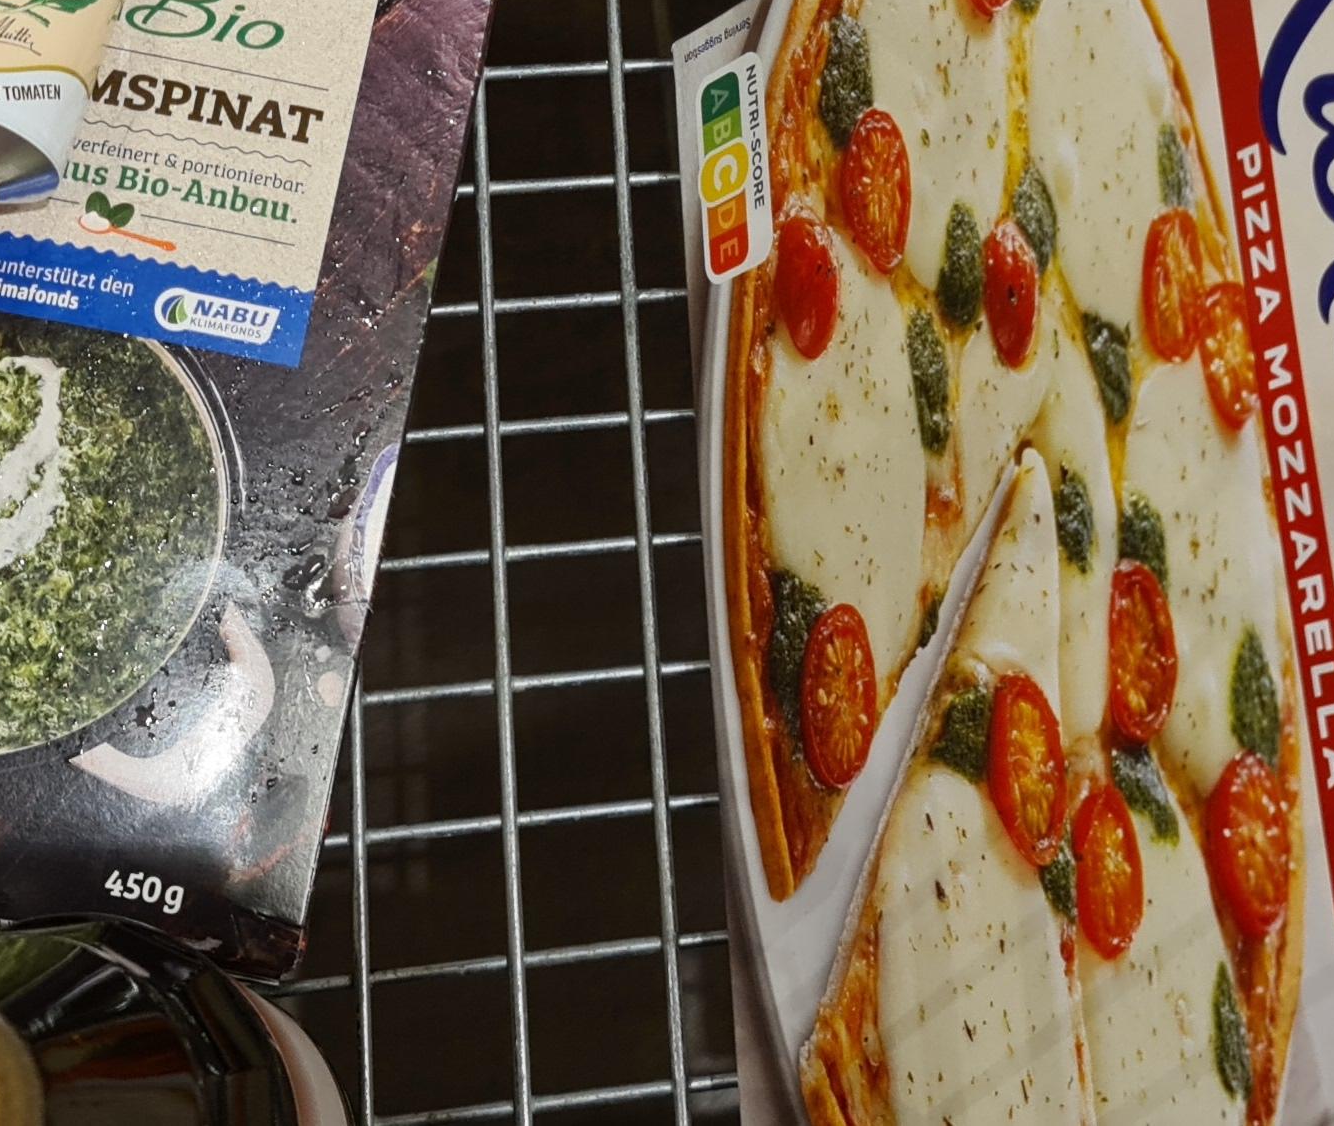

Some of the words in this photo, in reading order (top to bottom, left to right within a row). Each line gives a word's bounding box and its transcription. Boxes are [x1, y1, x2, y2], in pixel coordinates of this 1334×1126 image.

[682, 28, 723, 64] suggestion
[724, 15, 753, 43] Serving
[3, 83, 61, 100] TOMATEN
[88, 68, 324, 145] MSPINAT
[746, 63, 766, 211] NUTRI-SCORE
[166, 152, 179, 168] &
[182, 157, 306, 196] portionierbar.
[117, 165, 298, 225] Bio-Anbau.
[1236, 141, 1283, 325] PIZZA
[100, 274, 135, 297] den
[189, 316, 263, 339] KLIMAFONDS
[193, 298, 270, 330] NABU
